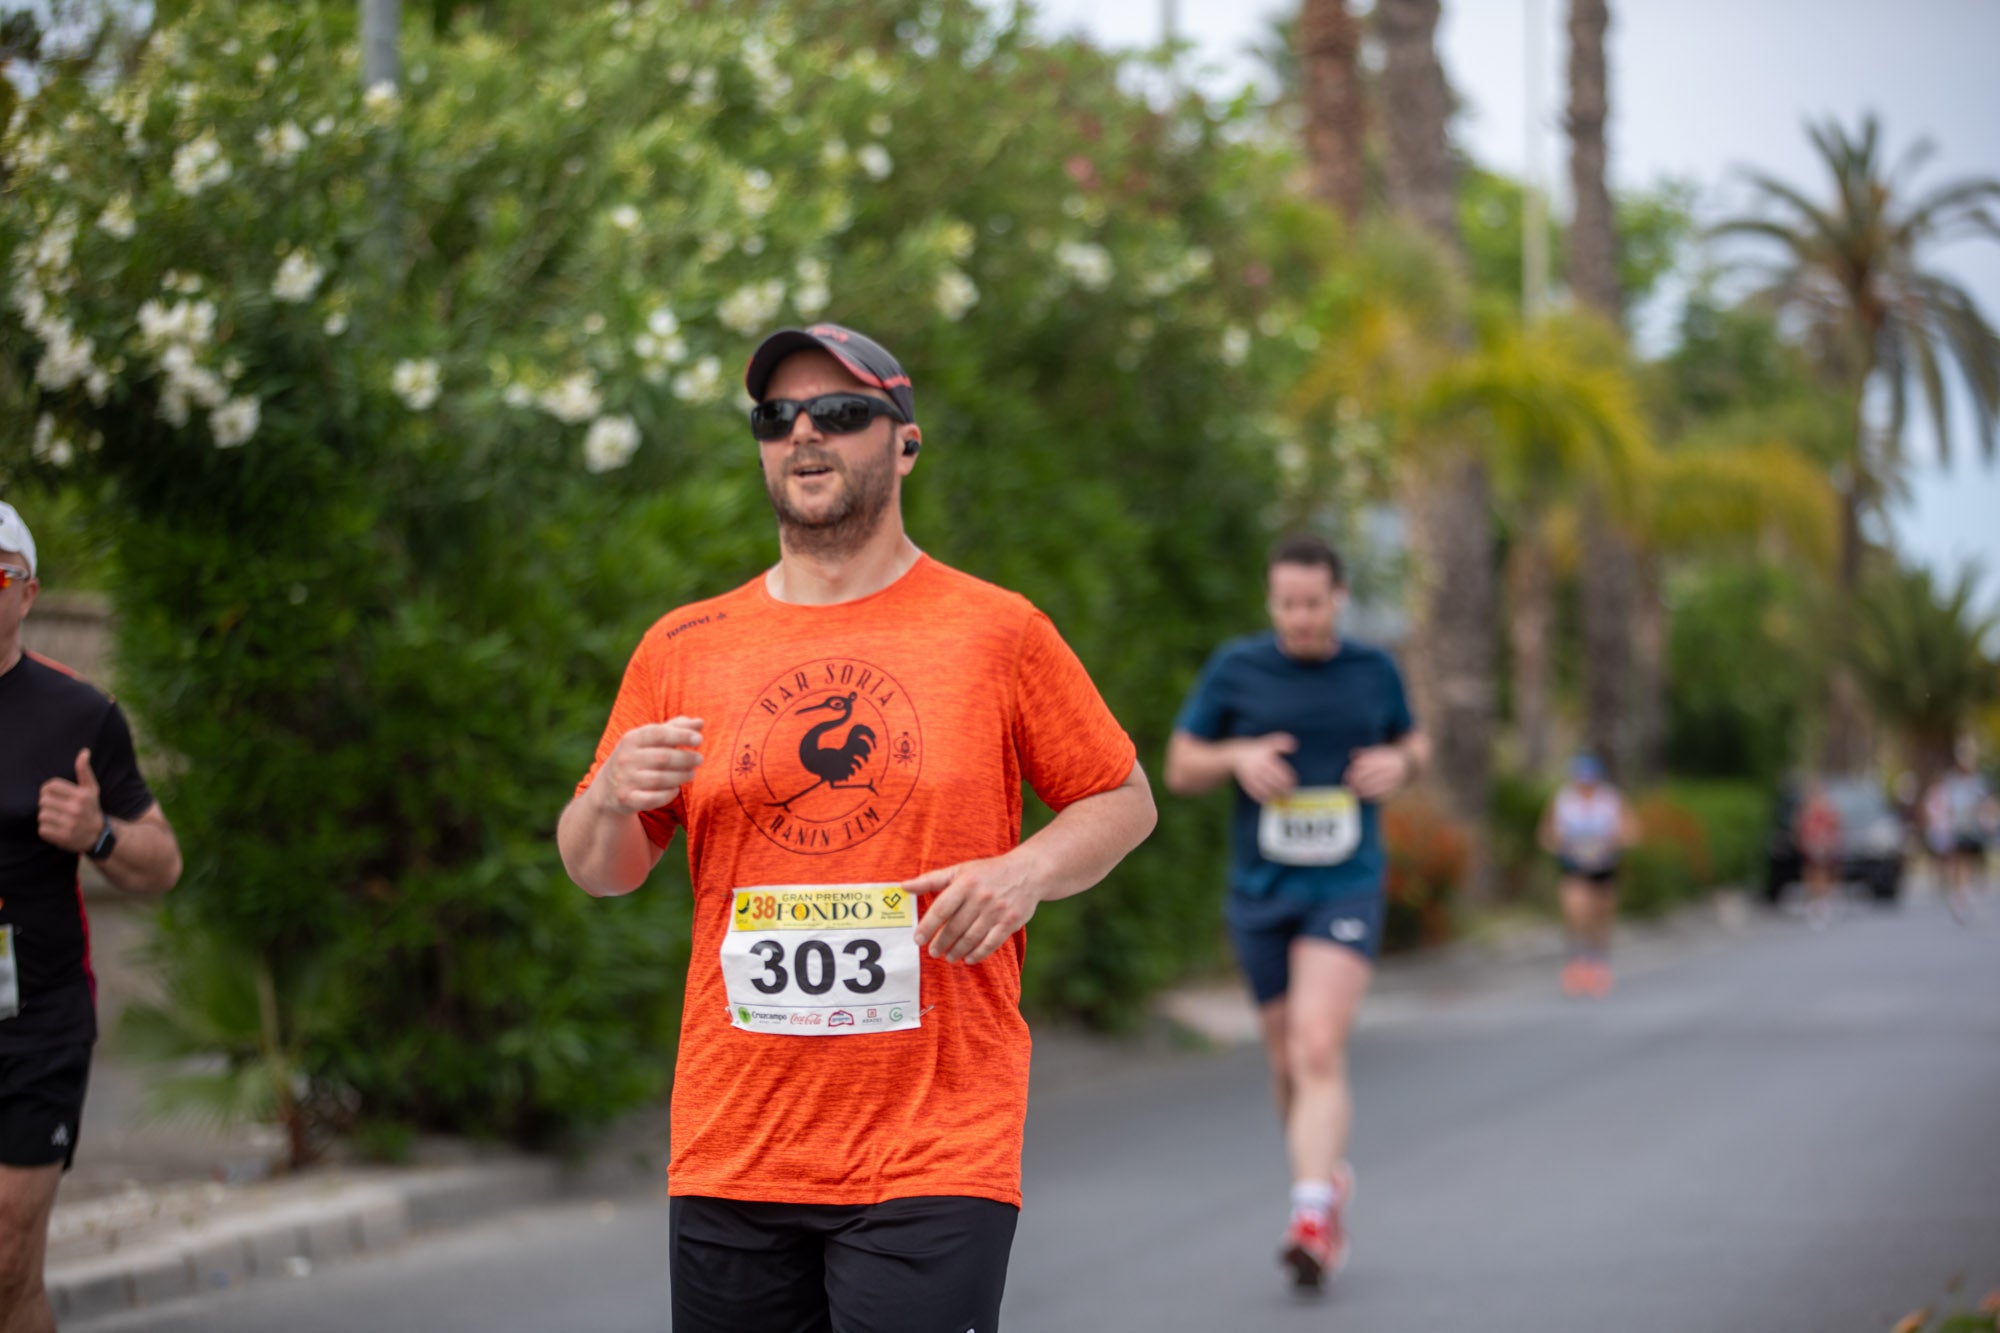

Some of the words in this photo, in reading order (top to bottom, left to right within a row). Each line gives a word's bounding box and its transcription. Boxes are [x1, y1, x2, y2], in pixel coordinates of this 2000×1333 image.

[760, 671, 809, 715] BAR
[824, 663, 895, 707] SORIA
[769, 814, 831, 847] RANIN
[843, 806, 880, 840] TIM
[752, 896, 776, 920] 38
[782, 893, 813, 902] GRAN
[816, 892, 863, 901] PREMIO
[776, 901, 873, 921] FONDO
[750, 939, 886, 995] 303
[751, 1010, 788, 1021] Cruzcampo
